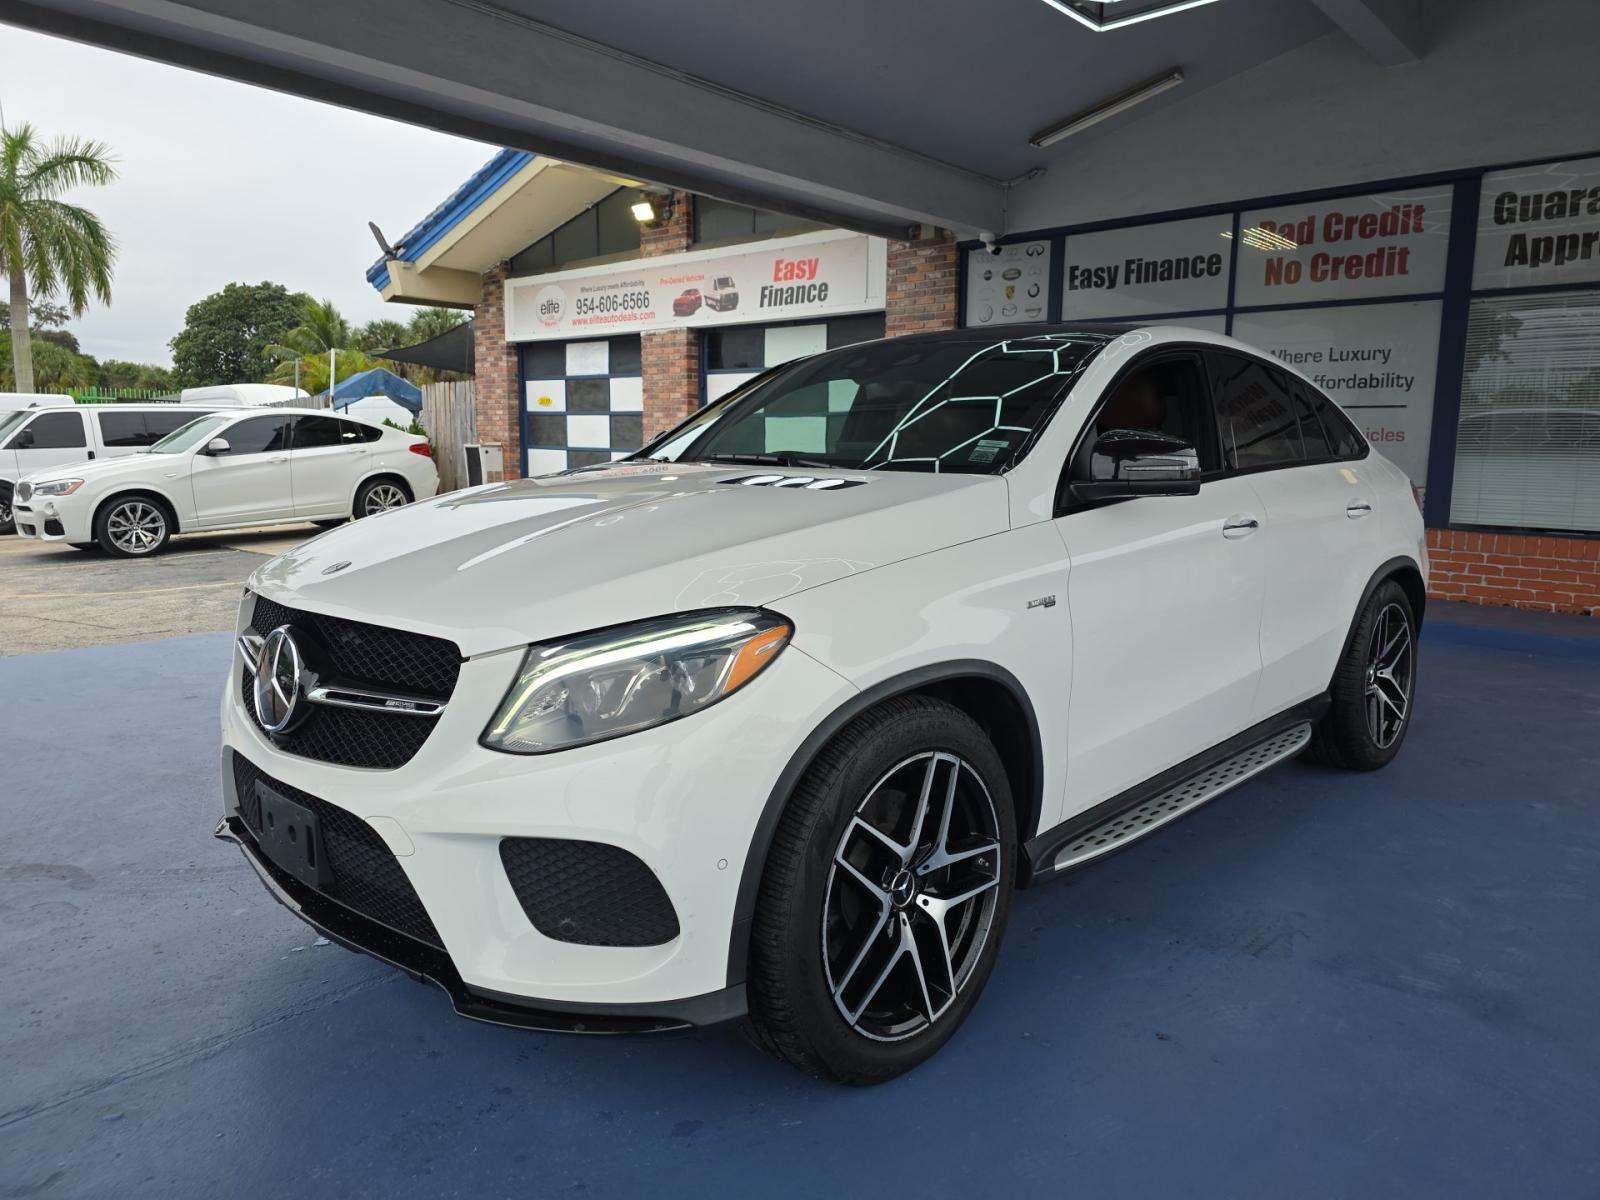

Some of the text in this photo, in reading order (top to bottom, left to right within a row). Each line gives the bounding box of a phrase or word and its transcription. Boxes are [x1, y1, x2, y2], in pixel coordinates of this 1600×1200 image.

[1493, 186, 1600, 226] Guara
[1322, 204, 1426, 243] Credit
[773, 257, 820, 283] Easy
[1068, 253, 1222, 291] Easy Finance
[1264, 246, 1410, 286] No Credit
[540, 297, 560, 316] elite
[576, 290, 650, 316] 954-606-6566
[759, 282, 829, 308] Finance
[572, 311, 656, 327] www.eliteautodeals.com
[1328, 347, 1392, 364] Luxury
[1309, 372, 1415, 392] ffordability
